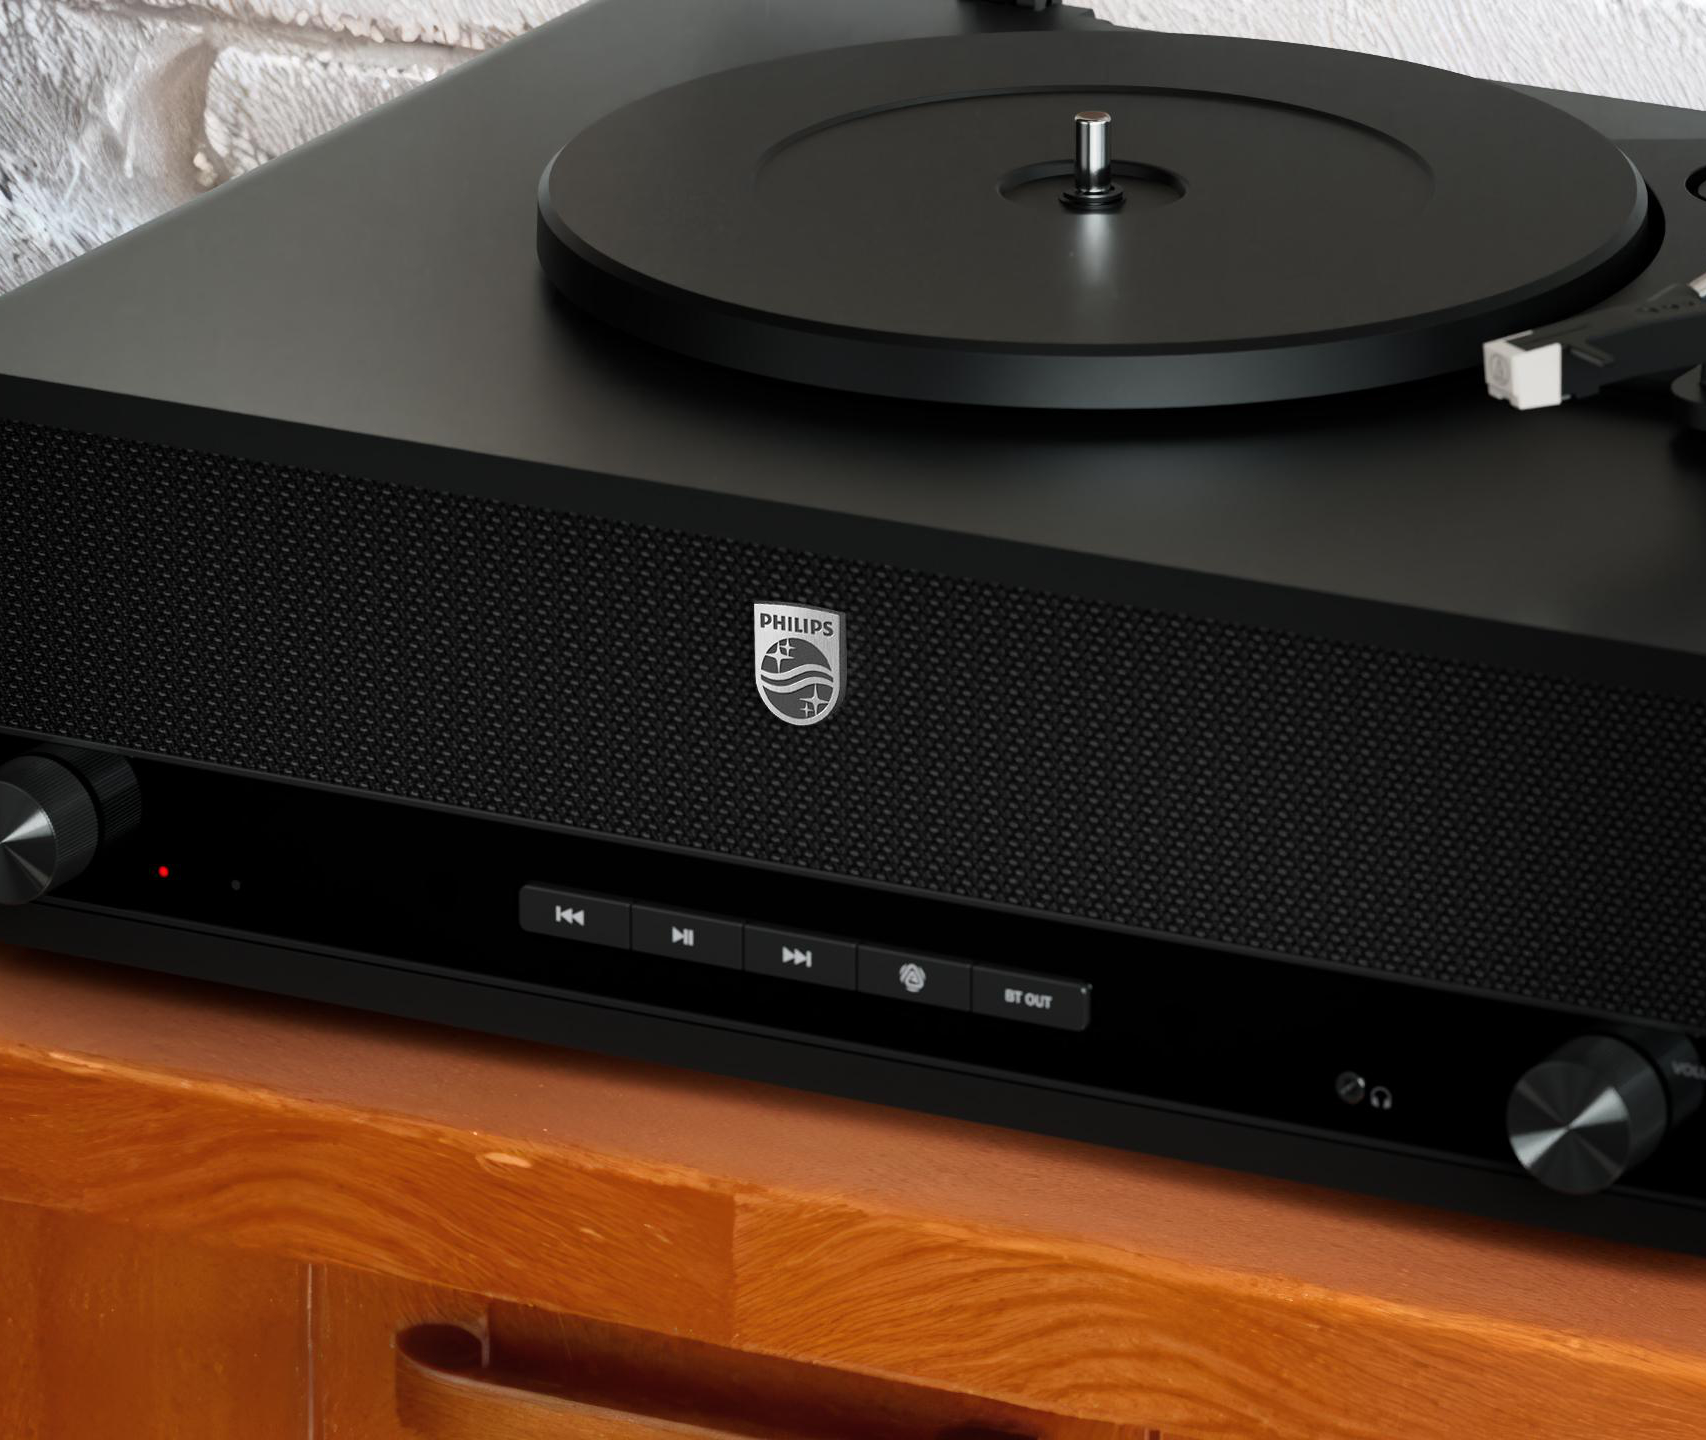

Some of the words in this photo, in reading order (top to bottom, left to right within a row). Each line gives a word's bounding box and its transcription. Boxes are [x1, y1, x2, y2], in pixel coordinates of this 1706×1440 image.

[760, 613, 834, 637] PHILIPS
[1004, 988, 1024, 1004] BT
[1024, 992, 1053, 1010] OUT
